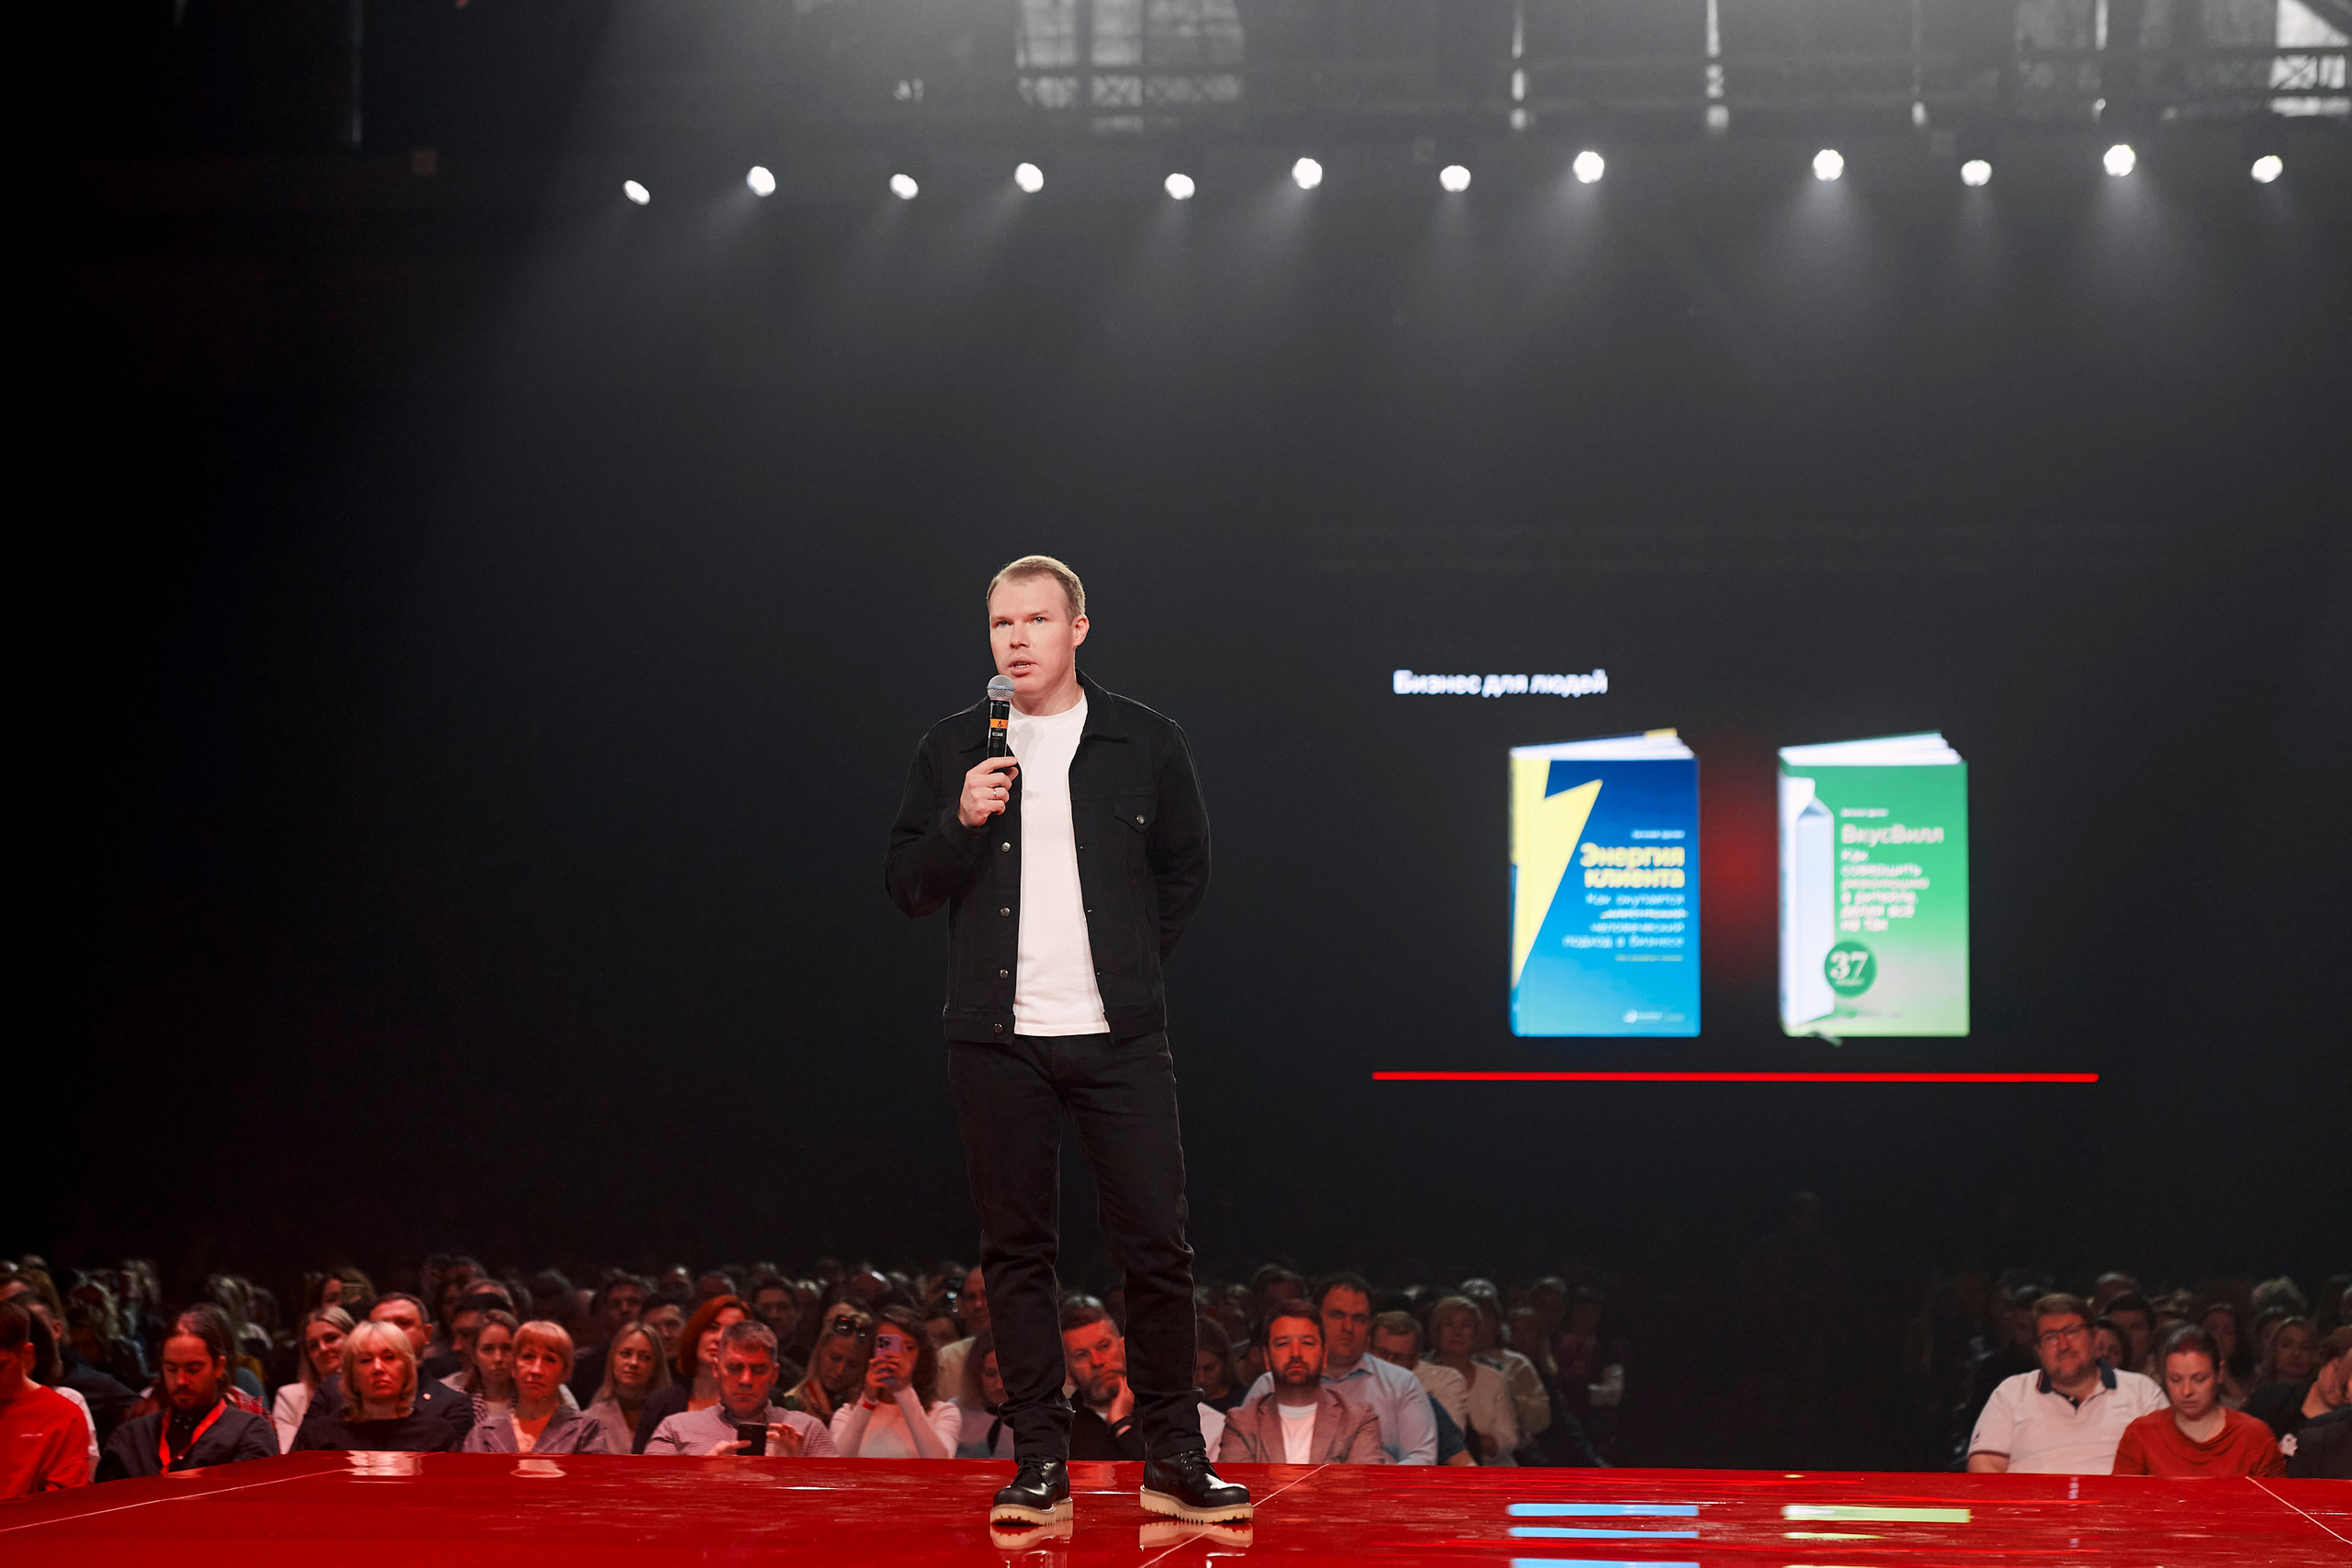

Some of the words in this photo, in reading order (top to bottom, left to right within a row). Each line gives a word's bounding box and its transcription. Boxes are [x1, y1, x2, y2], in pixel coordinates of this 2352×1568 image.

[1393, 669, 1482, 695] Бизнес
[1481, 673, 1530, 698] для
[1529, 668, 1609, 698] людей
[1841, 823, 1945, 848] ВкусВилл
[1579, 841, 1686, 867] Энергия
[1584, 867, 1686, 888] клиента
[1829, 951, 1870, 979] 37
